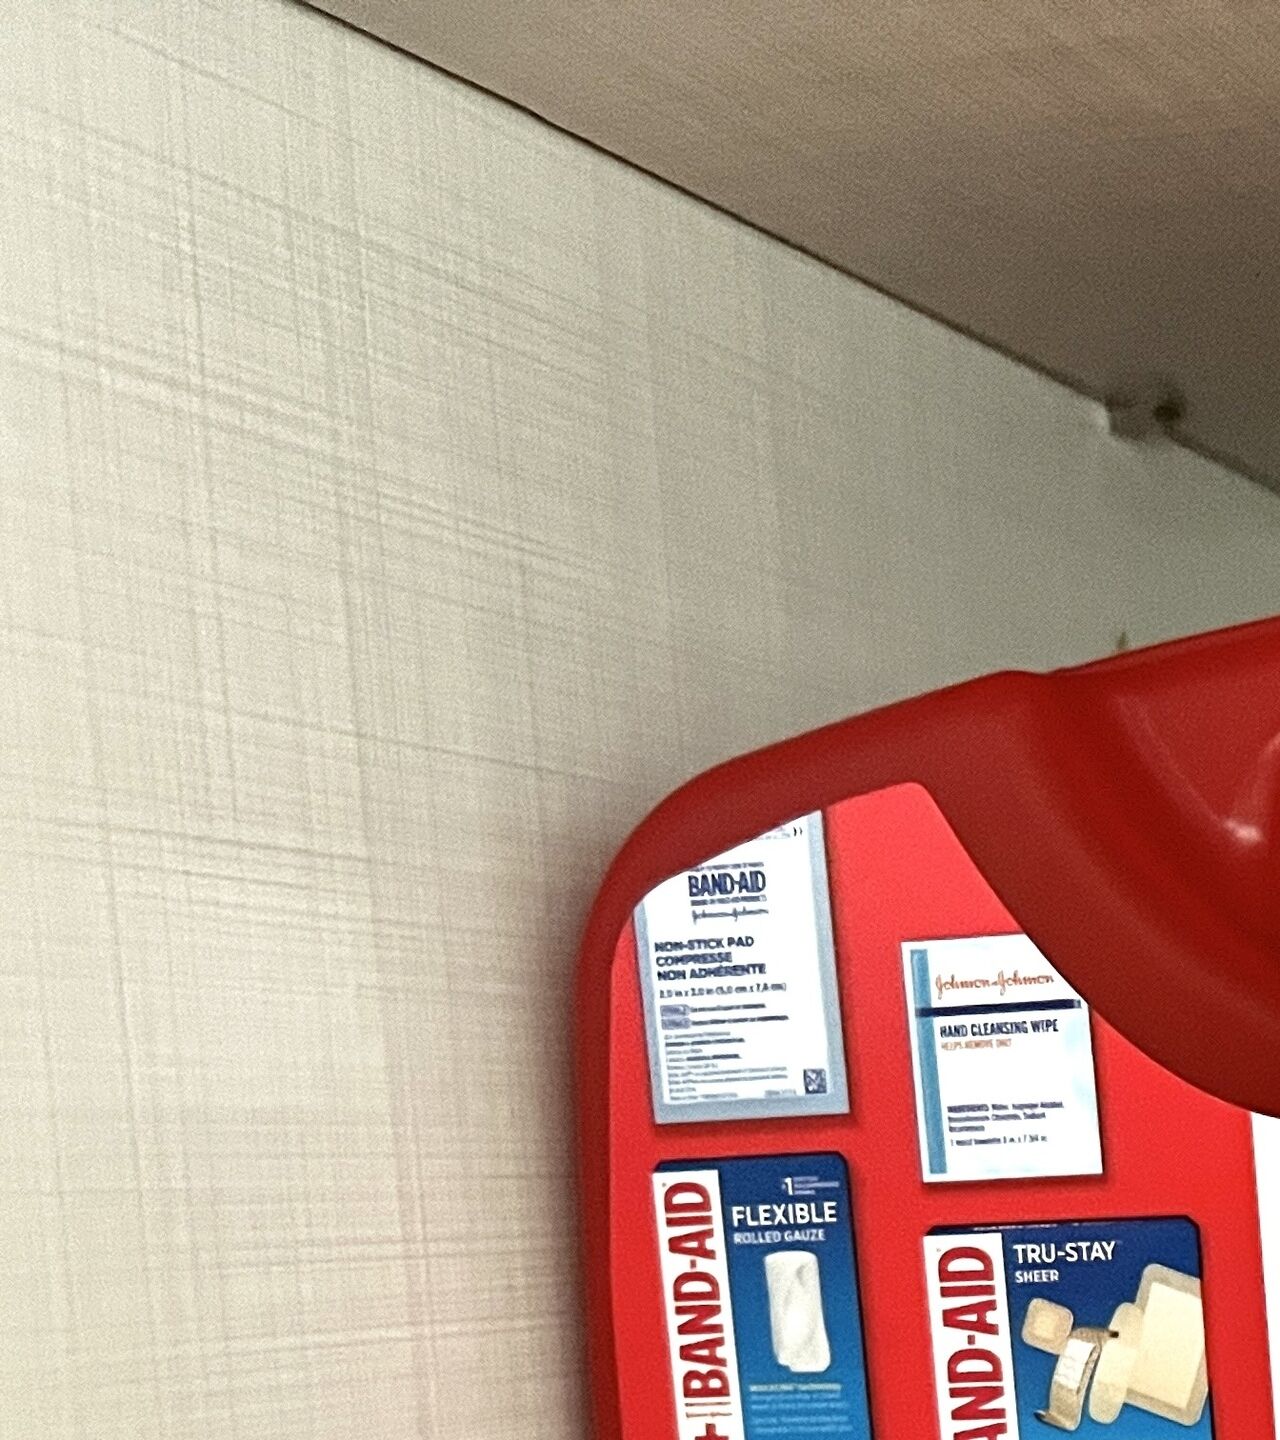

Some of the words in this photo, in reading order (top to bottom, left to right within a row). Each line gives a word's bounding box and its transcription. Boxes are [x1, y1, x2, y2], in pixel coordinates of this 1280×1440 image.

[687, 870, 767, 897] BAND-AID
[654, 938, 725, 953] NON-STICK
[727, 936, 755, 948] PAD
[656, 951, 733, 967] COMPRESSE
[657, 969, 687, 981] NON
[940, 1024, 968, 1038] HAND
[971, 1020, 1029, 1036] CLEANSING
[1030, 1019, 1059, 1033] WIPE
[731, 1201, 838, 1228] FLEXIBLE
[733, 1231, 782, 1245] ROLLED
[784, 1229, 826, 1243] GAUZE
[1013, 1241, 1116, 1264] TRU-STAY
[1015, 1269, 1060, 1284] SHEER
[663, 1180, 732, 1399] BAND-AID
